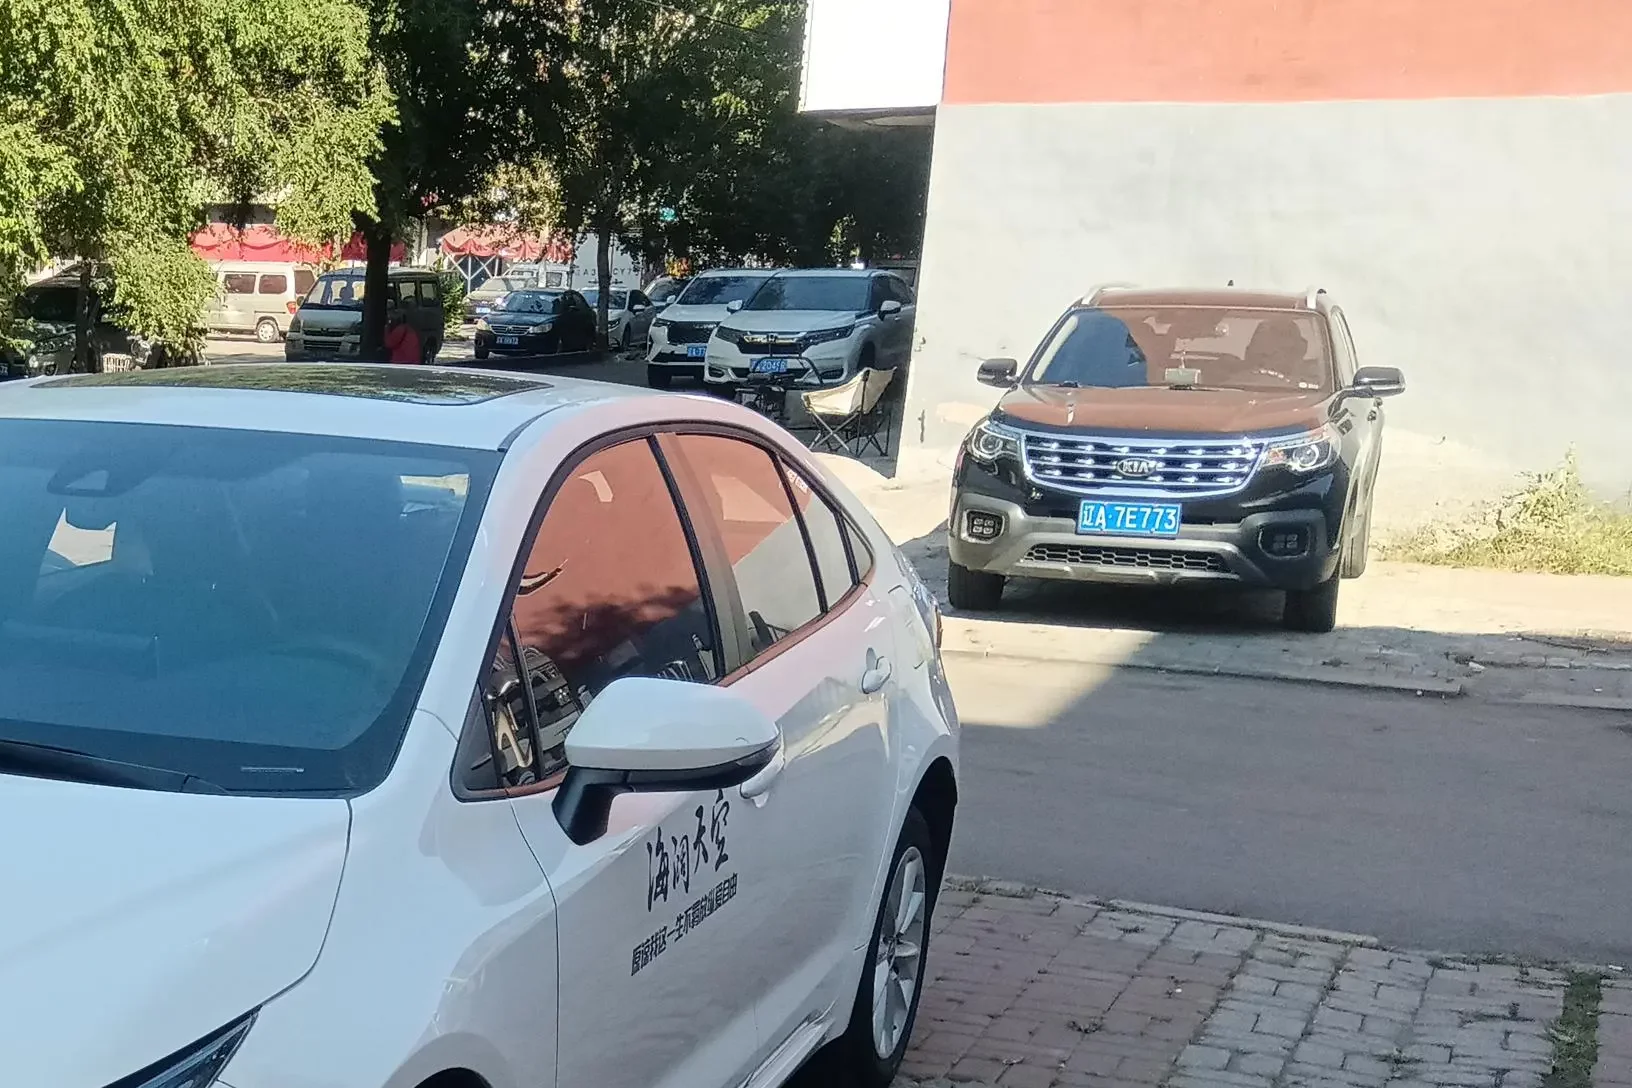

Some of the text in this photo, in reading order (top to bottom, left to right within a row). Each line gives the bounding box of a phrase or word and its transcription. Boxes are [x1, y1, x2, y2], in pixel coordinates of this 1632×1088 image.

[1122, 460, 1149, 473] KIA
[646, 788, 731, 914] 海阔天空
